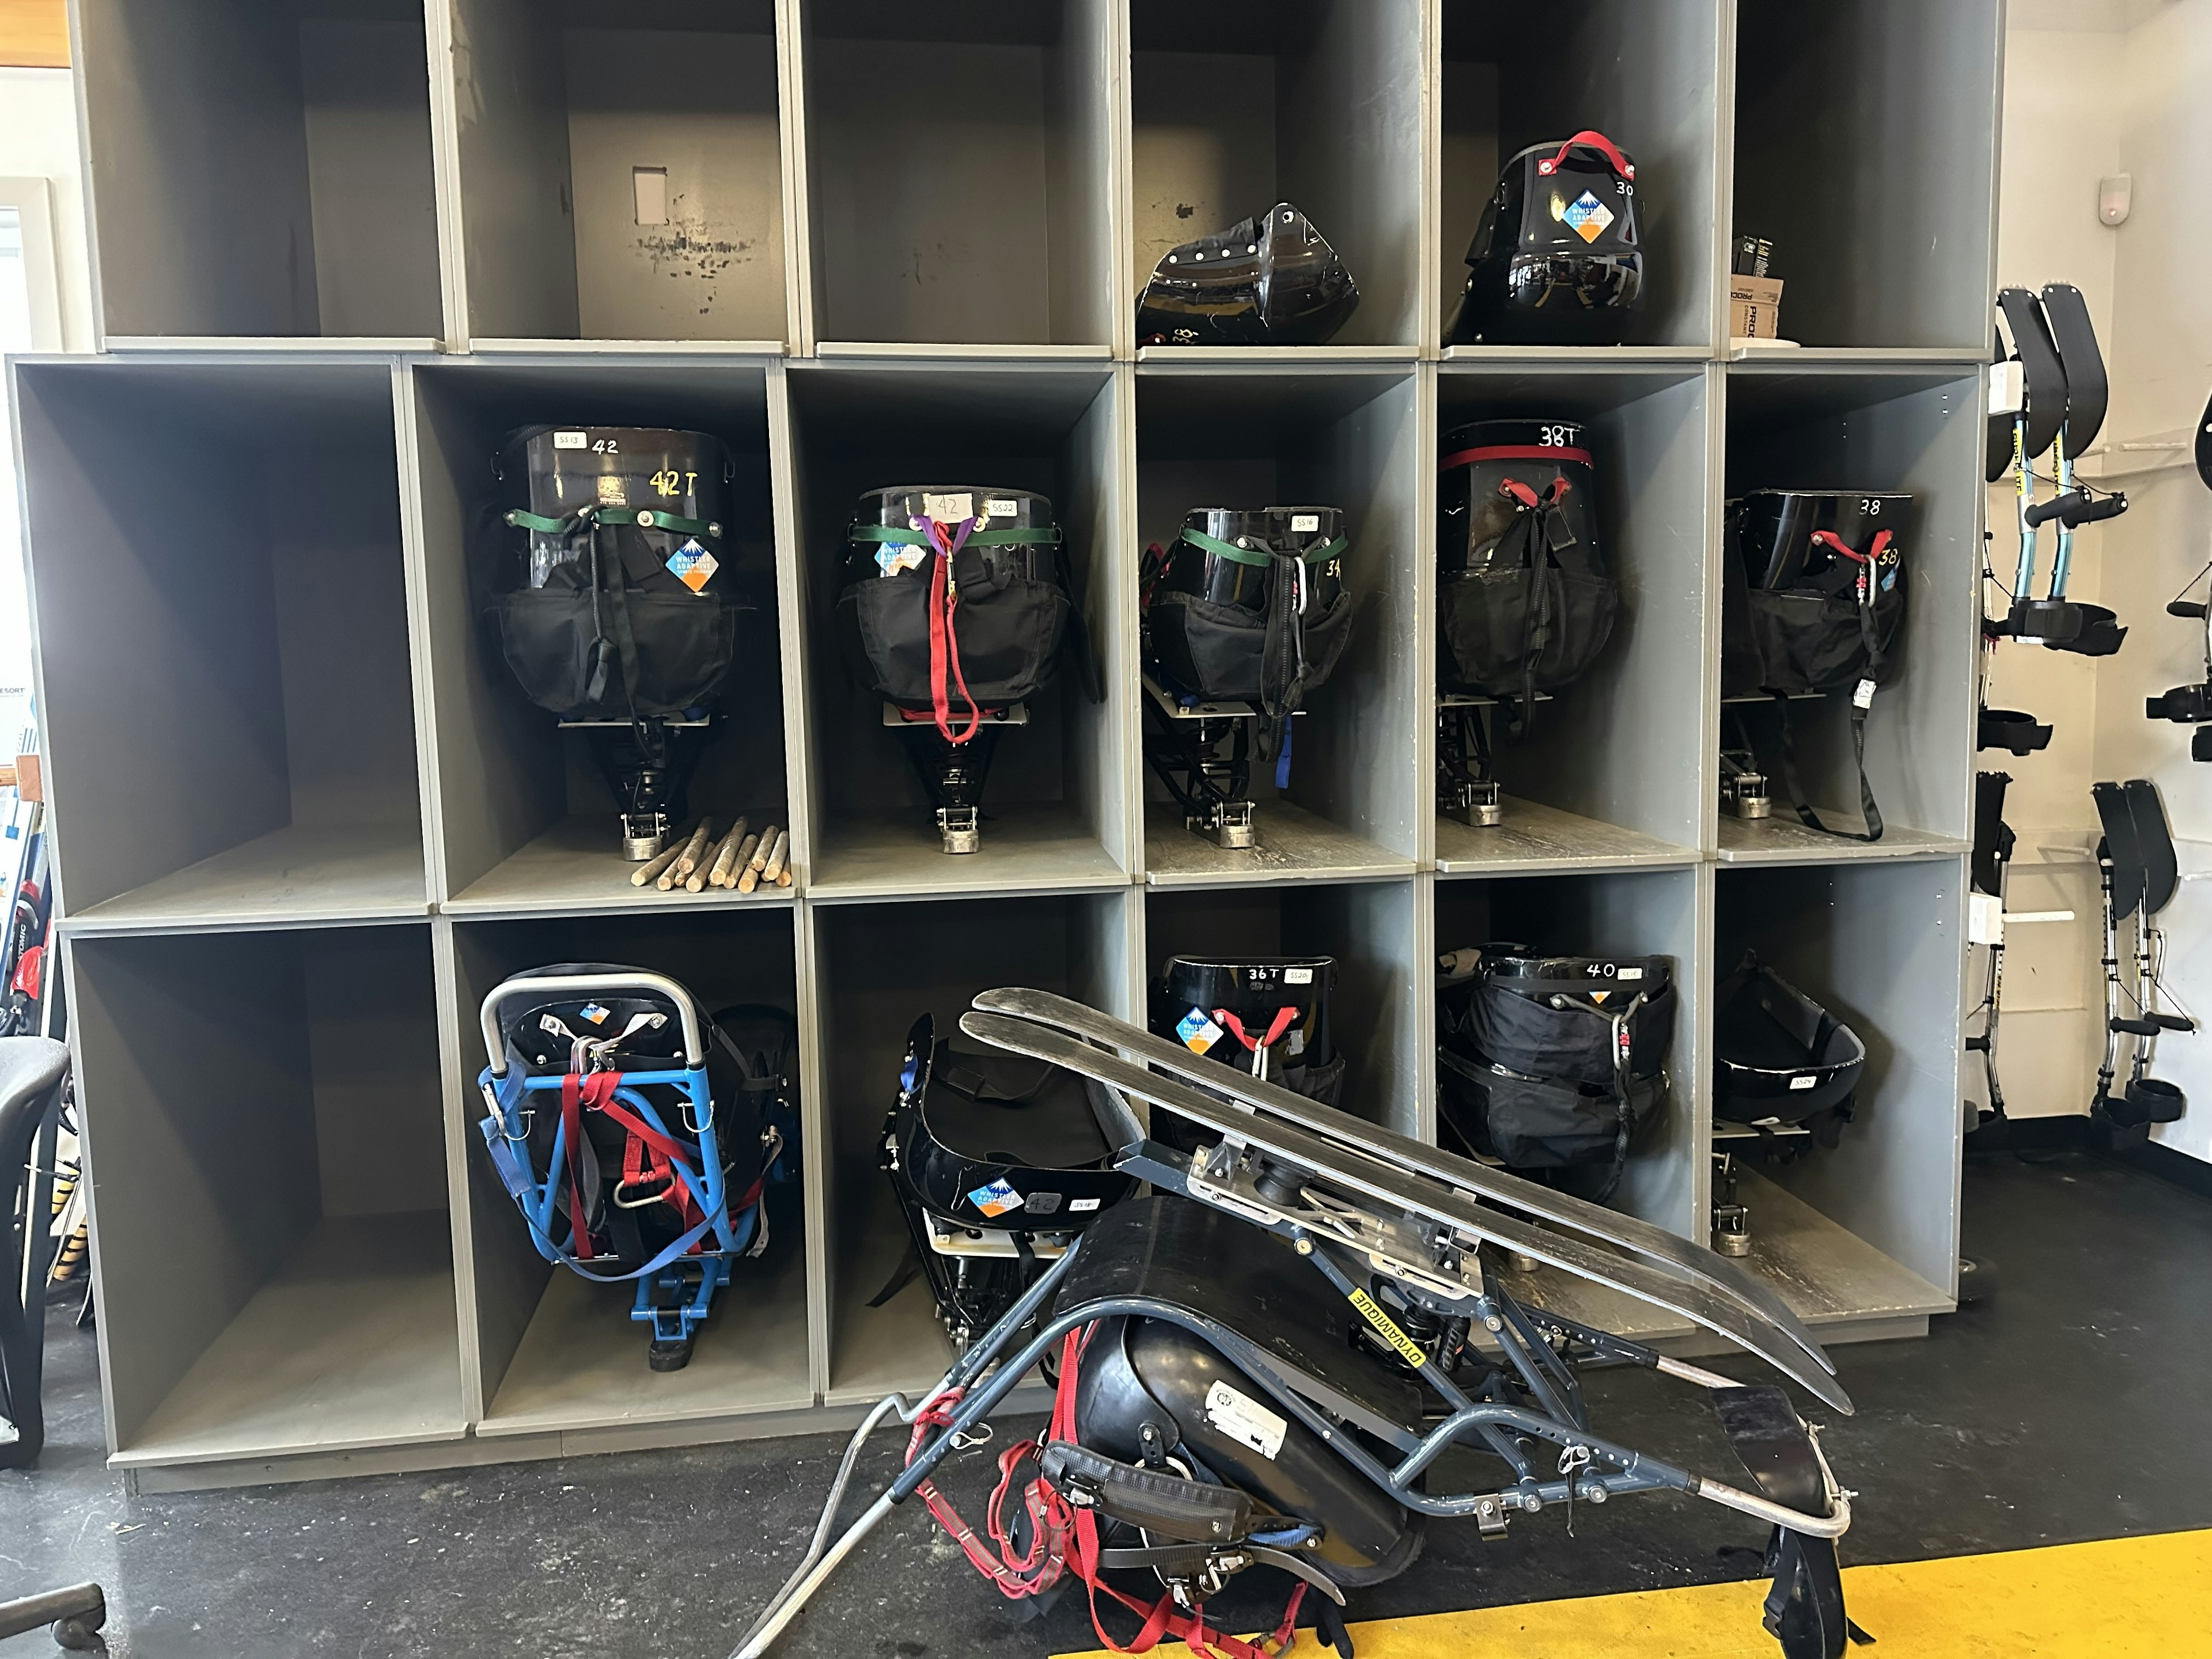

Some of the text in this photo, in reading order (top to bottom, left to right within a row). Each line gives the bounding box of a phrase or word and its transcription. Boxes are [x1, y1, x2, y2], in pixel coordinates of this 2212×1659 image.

[1616, 181, 1634, 196] 30
[1730, 291, 1753, 300] PROC
[1538, 425, 1581, 448] 38T
[592, 439, 619, 455] 42
[937, 496, 1014, 514] 42 SS22
[1859, 499, 1881, 516] 38
[1878, 548, 1899, 566] 38
[1586, 963, 1615, 978] 40
[978, 1195, 1014, 1205] ADAPTIVE
[980, 1190, 1016, 1199] WHISTLER
[1031, 1198, 1054, 1210] 42
[1353, 1293, 1422, 1363] DYNAMIQUE
